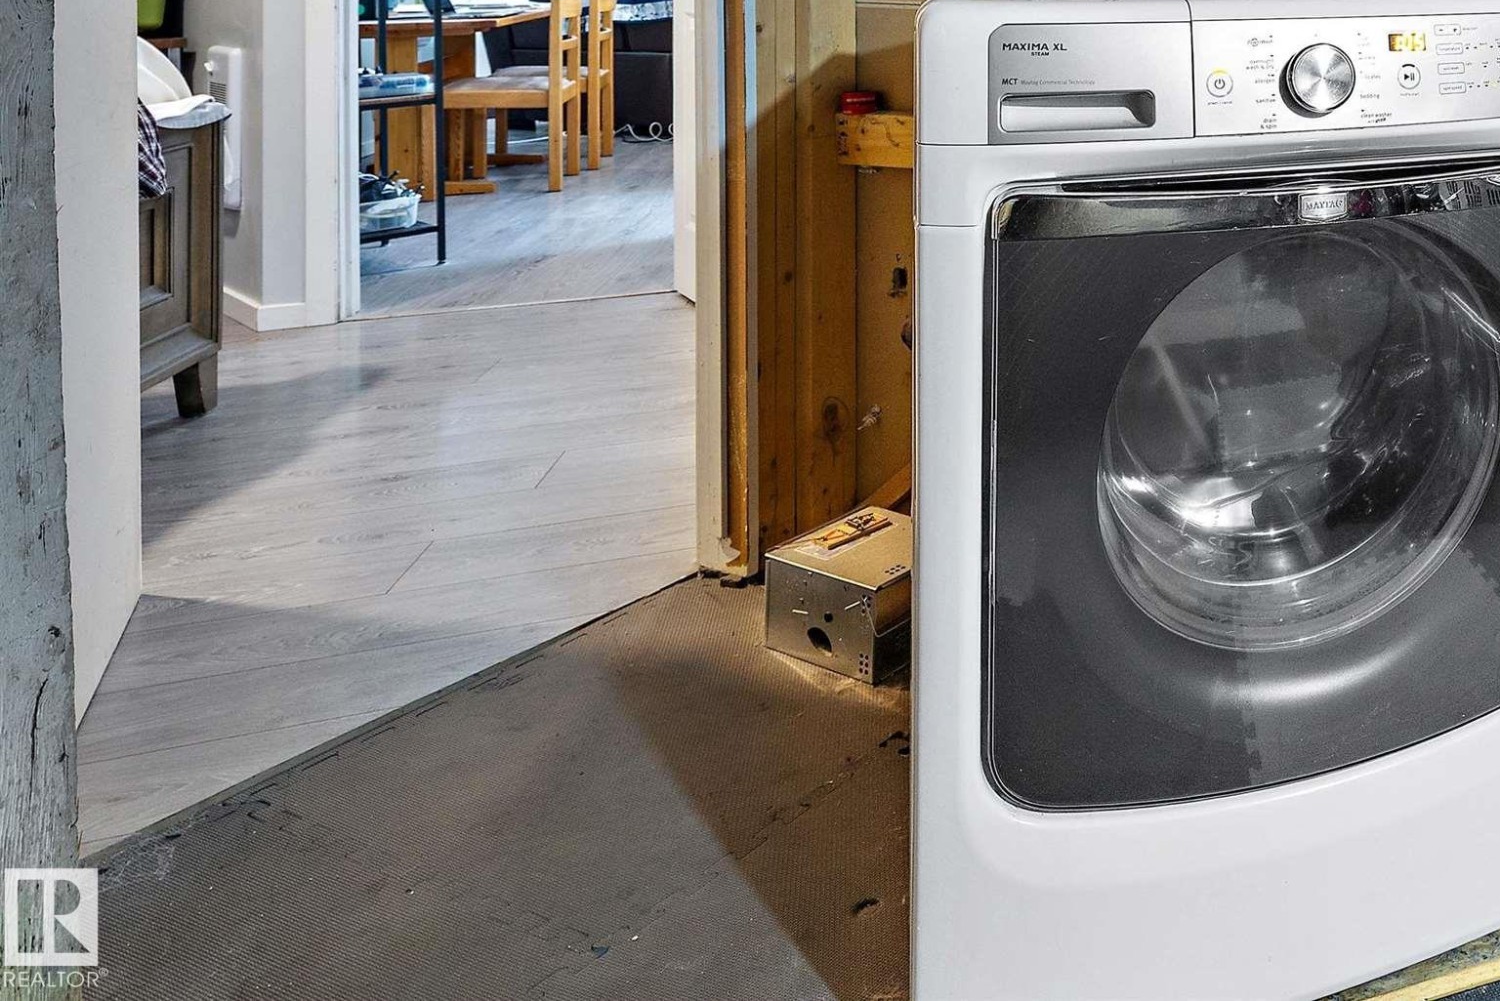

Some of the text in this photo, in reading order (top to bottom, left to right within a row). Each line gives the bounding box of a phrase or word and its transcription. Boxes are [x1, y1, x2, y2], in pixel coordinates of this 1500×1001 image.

[1002, 43, 1068, 51] MAXIMA XL
[1001, 78, 1018, 86] MCT
[1304, 199, 1344, 211] MAYTAG
